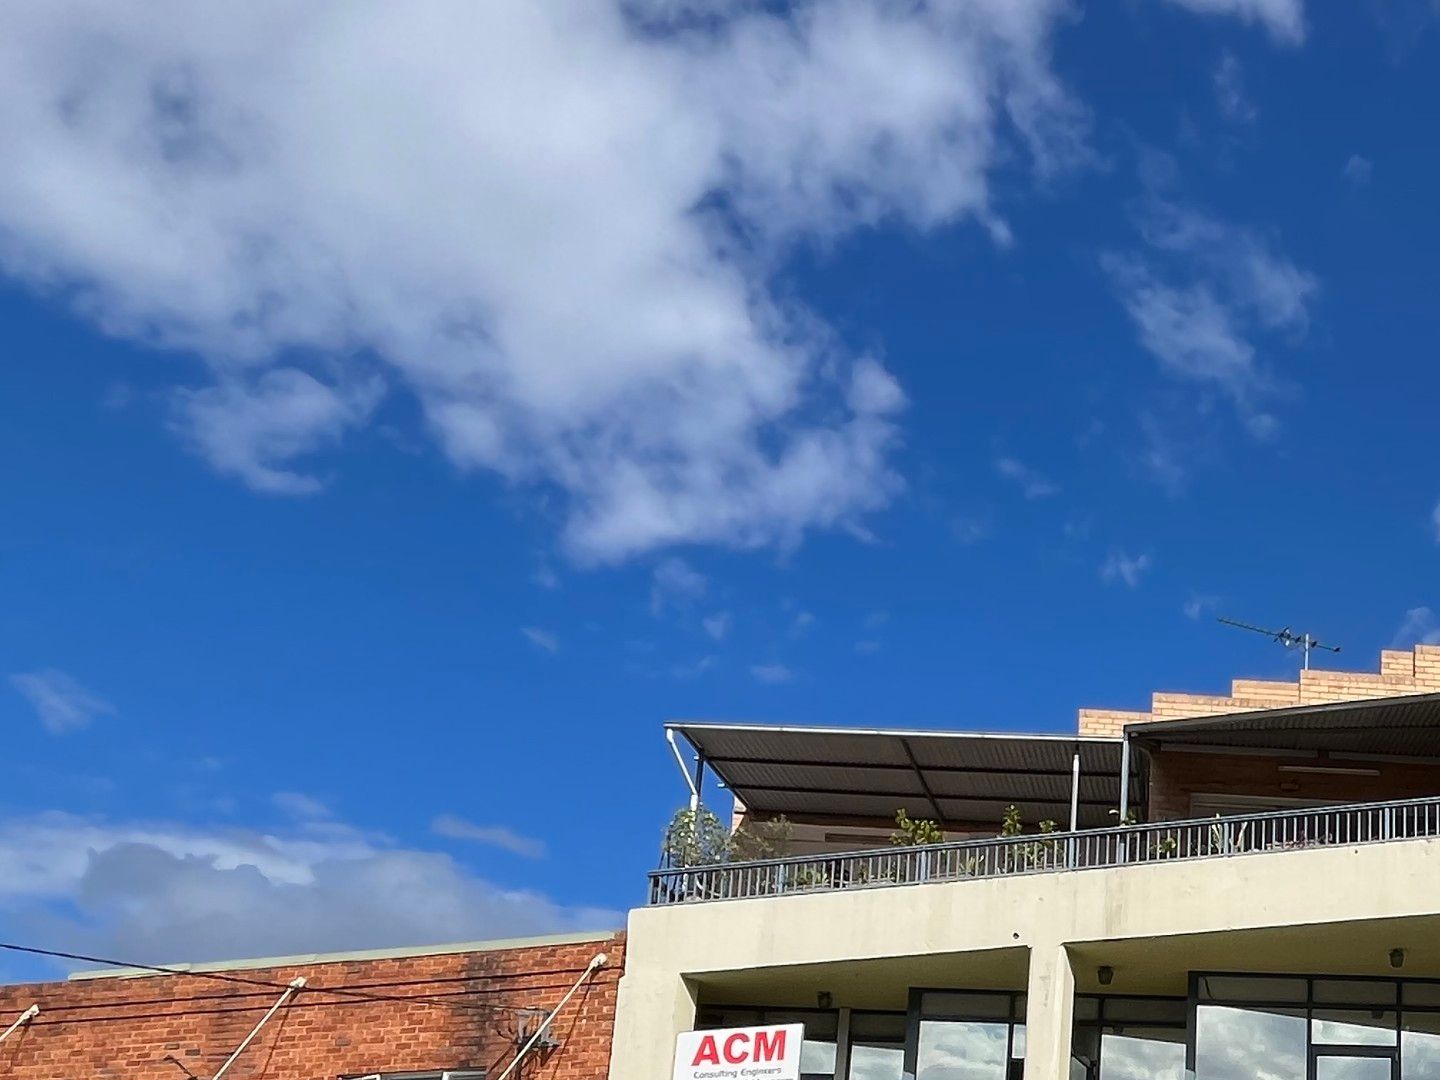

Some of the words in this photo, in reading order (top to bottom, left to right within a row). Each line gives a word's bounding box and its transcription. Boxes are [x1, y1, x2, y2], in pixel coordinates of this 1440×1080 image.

[691, 1030, 786, 1066] ACM
[693, 1069, 737, 1079] Consulting
[740, 1066, 782, 1076] Engineers
